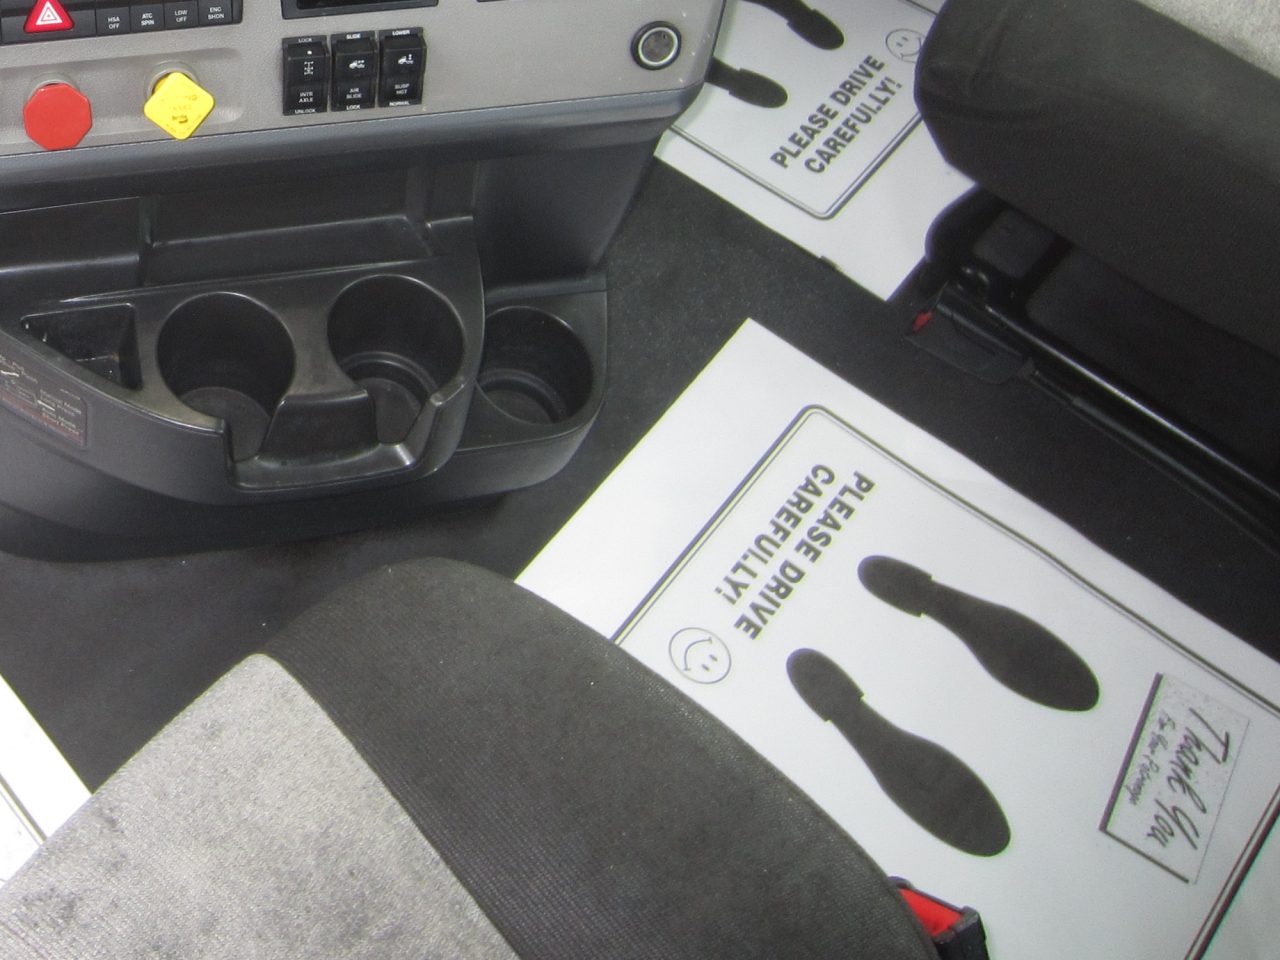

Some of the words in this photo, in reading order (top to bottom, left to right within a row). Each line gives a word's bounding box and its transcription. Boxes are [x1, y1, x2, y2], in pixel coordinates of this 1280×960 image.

[770, 104, 839, 169] PLEASE
[830, 55, 886, 107] DRIVE
[794, 470, 876, 563] PLEASE
[734, 559, 806, 640] DRIVE
[1167, 707, 1230, 814] Thank
[1146, 798, 1200, 851] You
